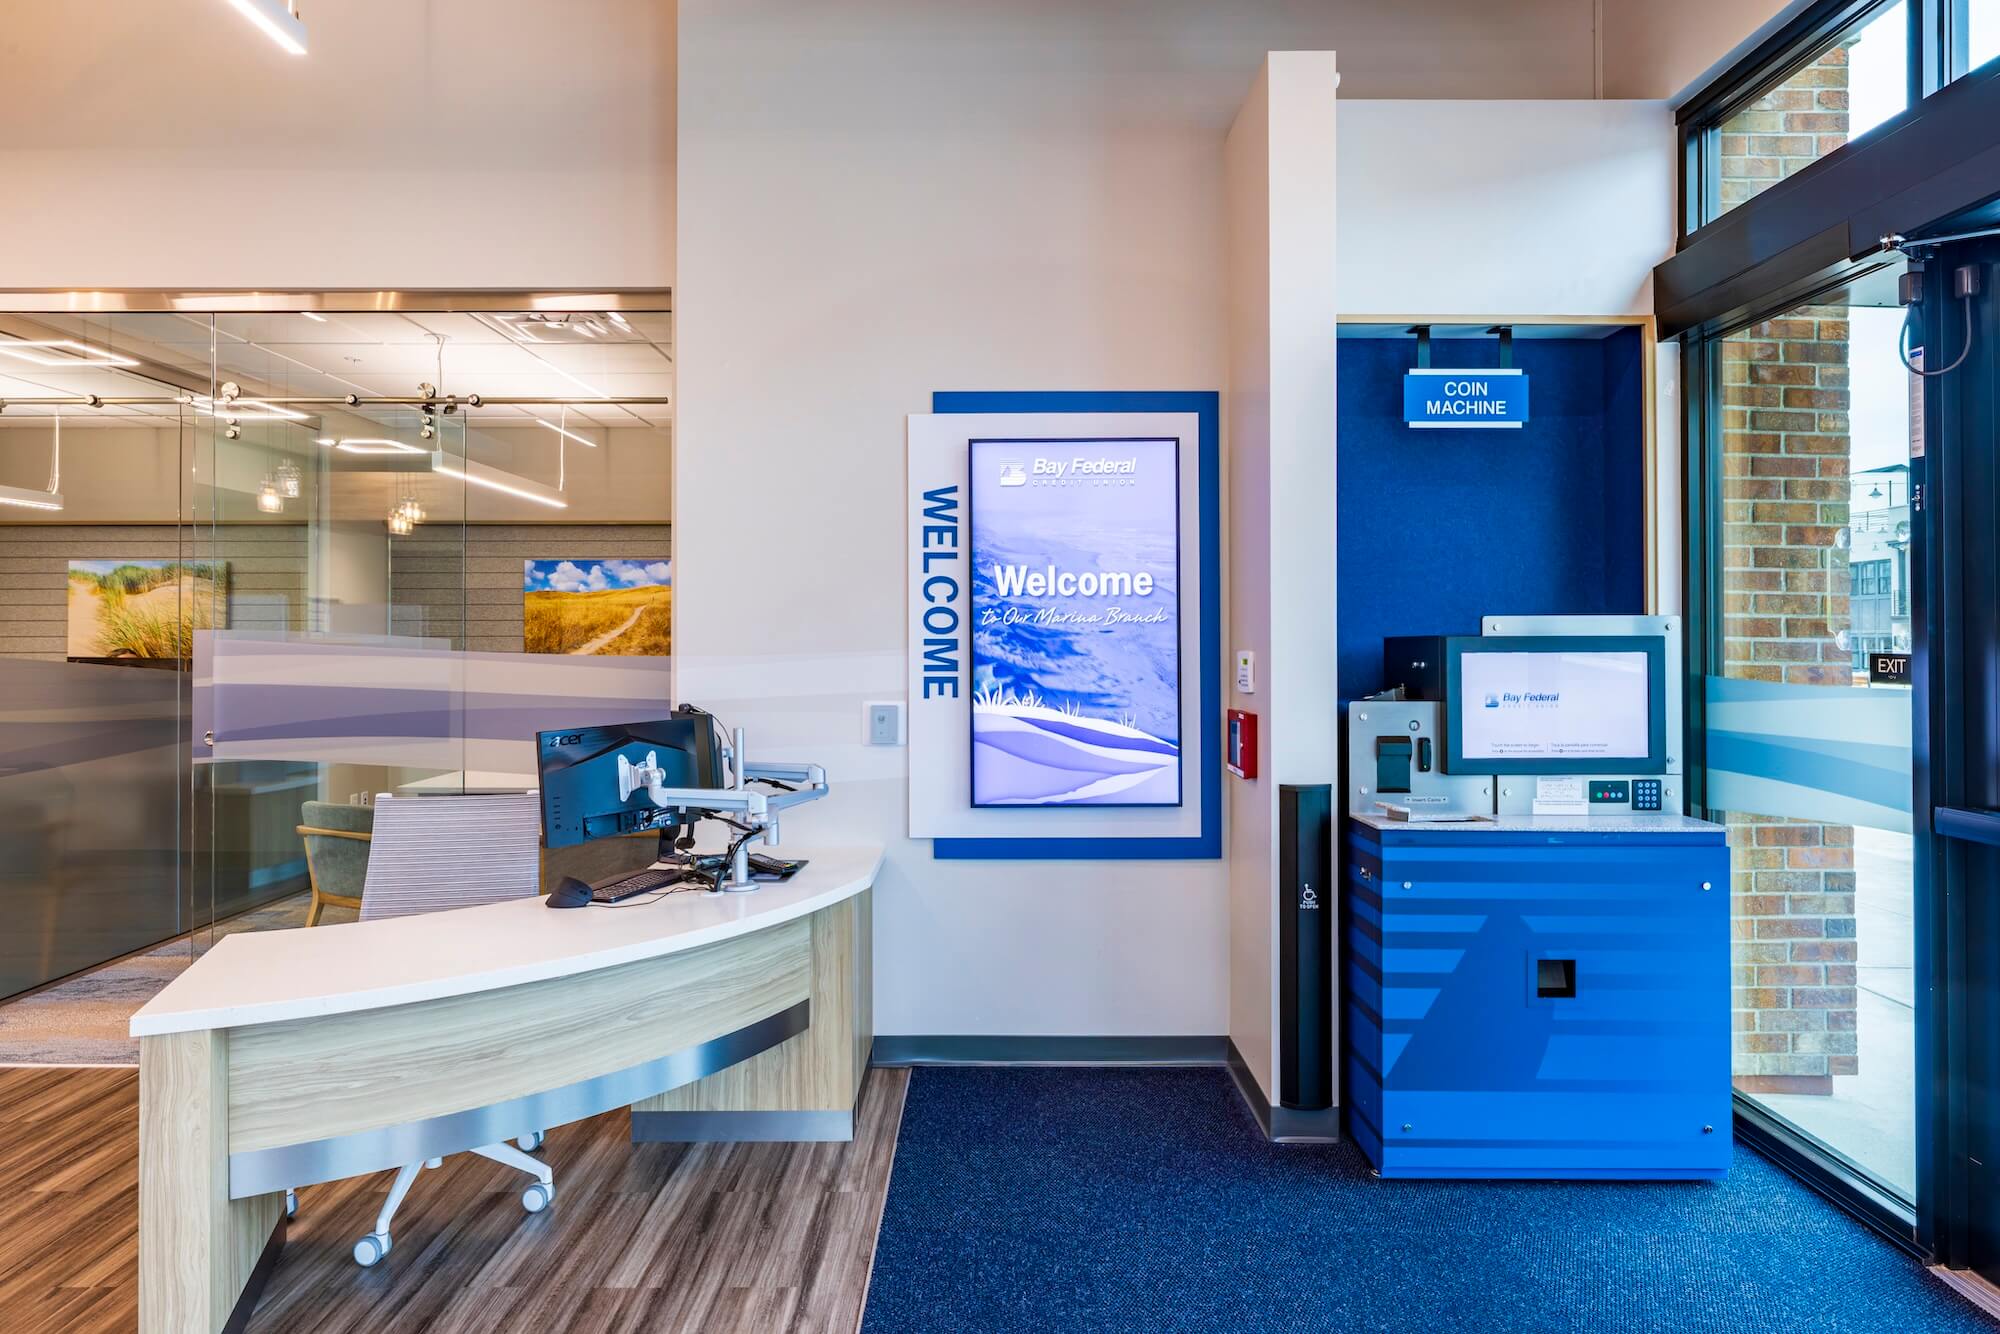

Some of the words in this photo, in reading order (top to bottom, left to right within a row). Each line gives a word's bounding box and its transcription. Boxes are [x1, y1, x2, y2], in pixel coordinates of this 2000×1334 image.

[1444, 381, 1488, 397] COIN
[1426, 400, 1507, 415] MACHINE
[1032, 458, 1068, 478] Bay
[1071, 457, 1136, 475] Federal
[1032, 479, 1082, 487] CREDIT
[1093, 479, 1136, 487] UNION
[993, 564, 1154, 598] Welcome
[923, 485, 959, 699] WELCOME
[981, 608, 1001, 626] to
[1002, 606, 1032, 625] Our
[1033, 606, 1101, 626] Marina
[1102, 606, 1167, 626] Branch
[1878, 658, 1906, 673] EXIT
[1503, 692, 1521, 704] Bay
[1523, 691, 1560, 702] Federal
[549, 733, 585, 747] acer
